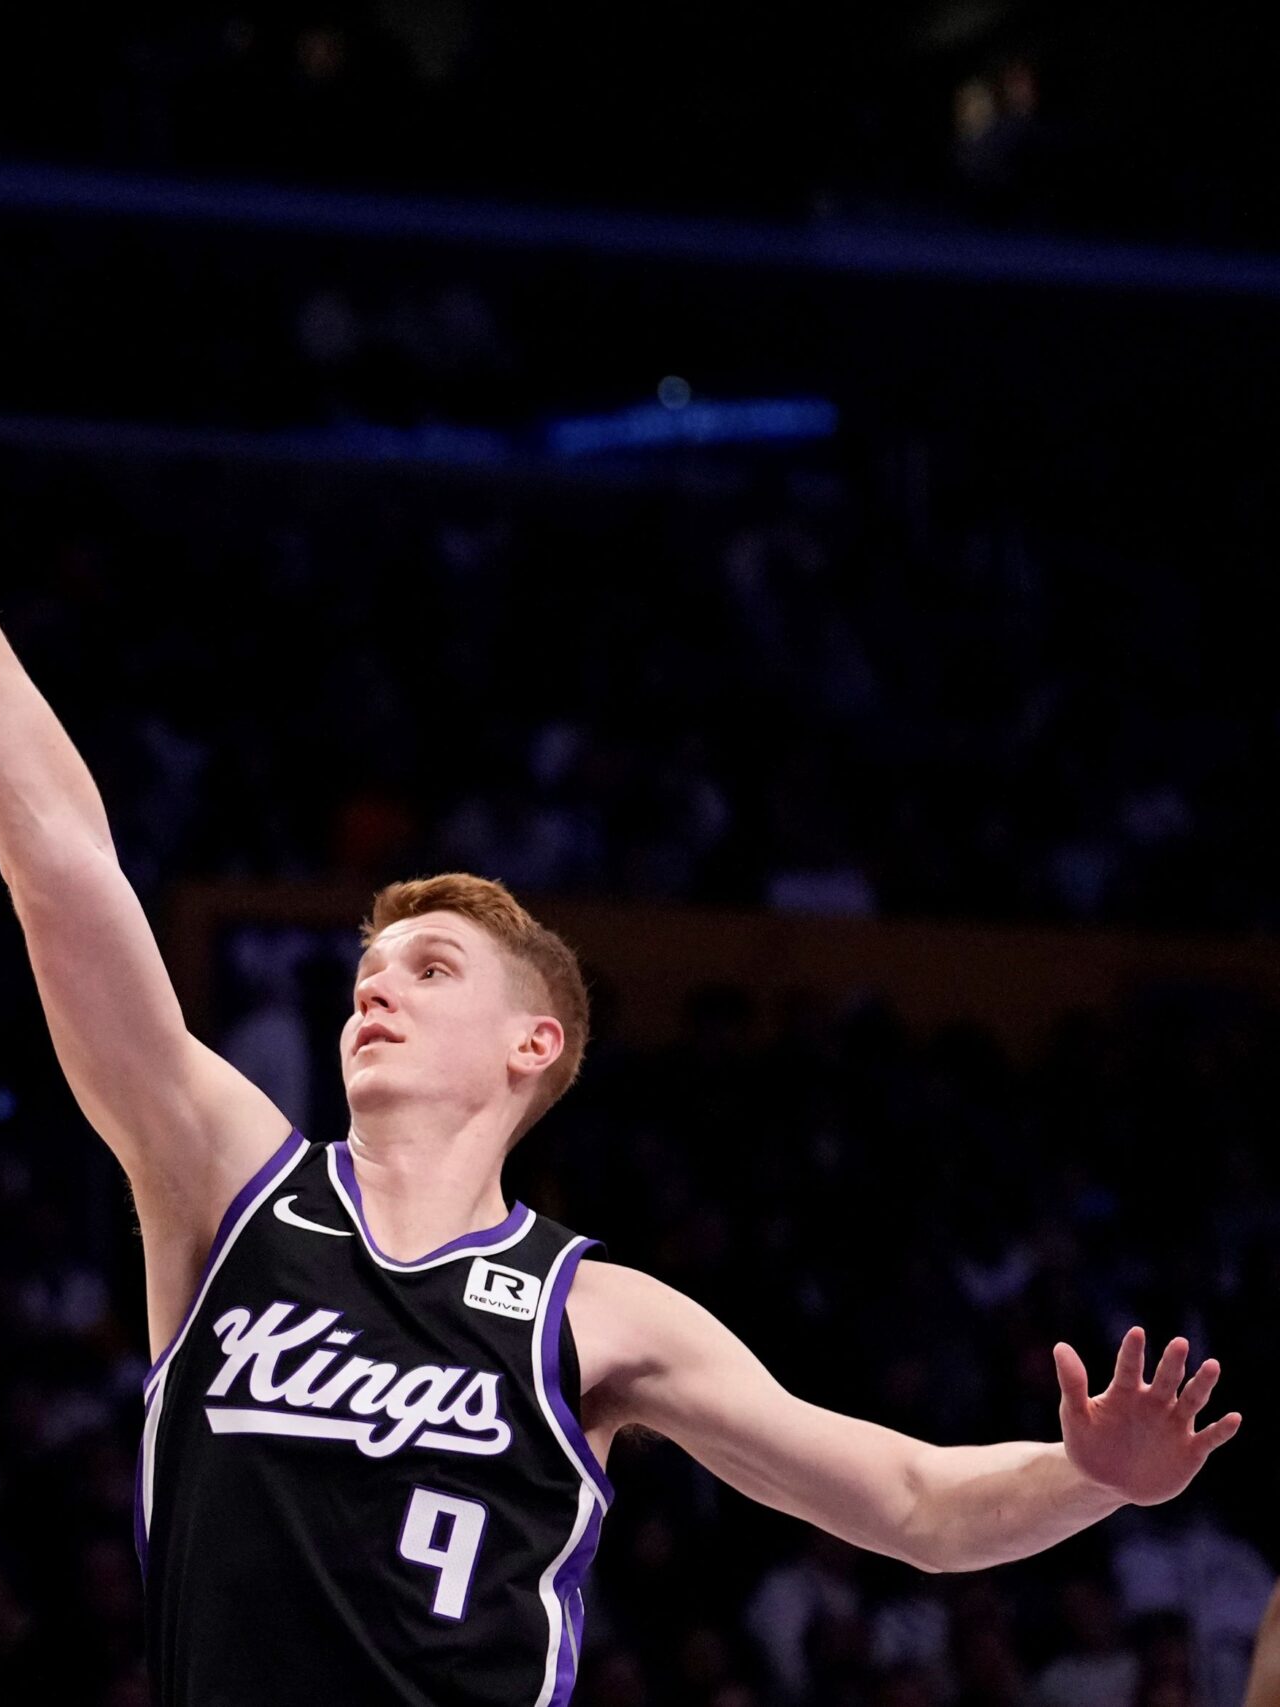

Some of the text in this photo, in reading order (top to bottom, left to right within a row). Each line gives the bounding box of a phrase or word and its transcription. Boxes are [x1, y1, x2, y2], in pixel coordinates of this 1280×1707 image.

[469, 1294, 530, 1314] REVIVER
[205, 1300, 513, 1459] Kings
[396, 1484, 488, 1623] 9
